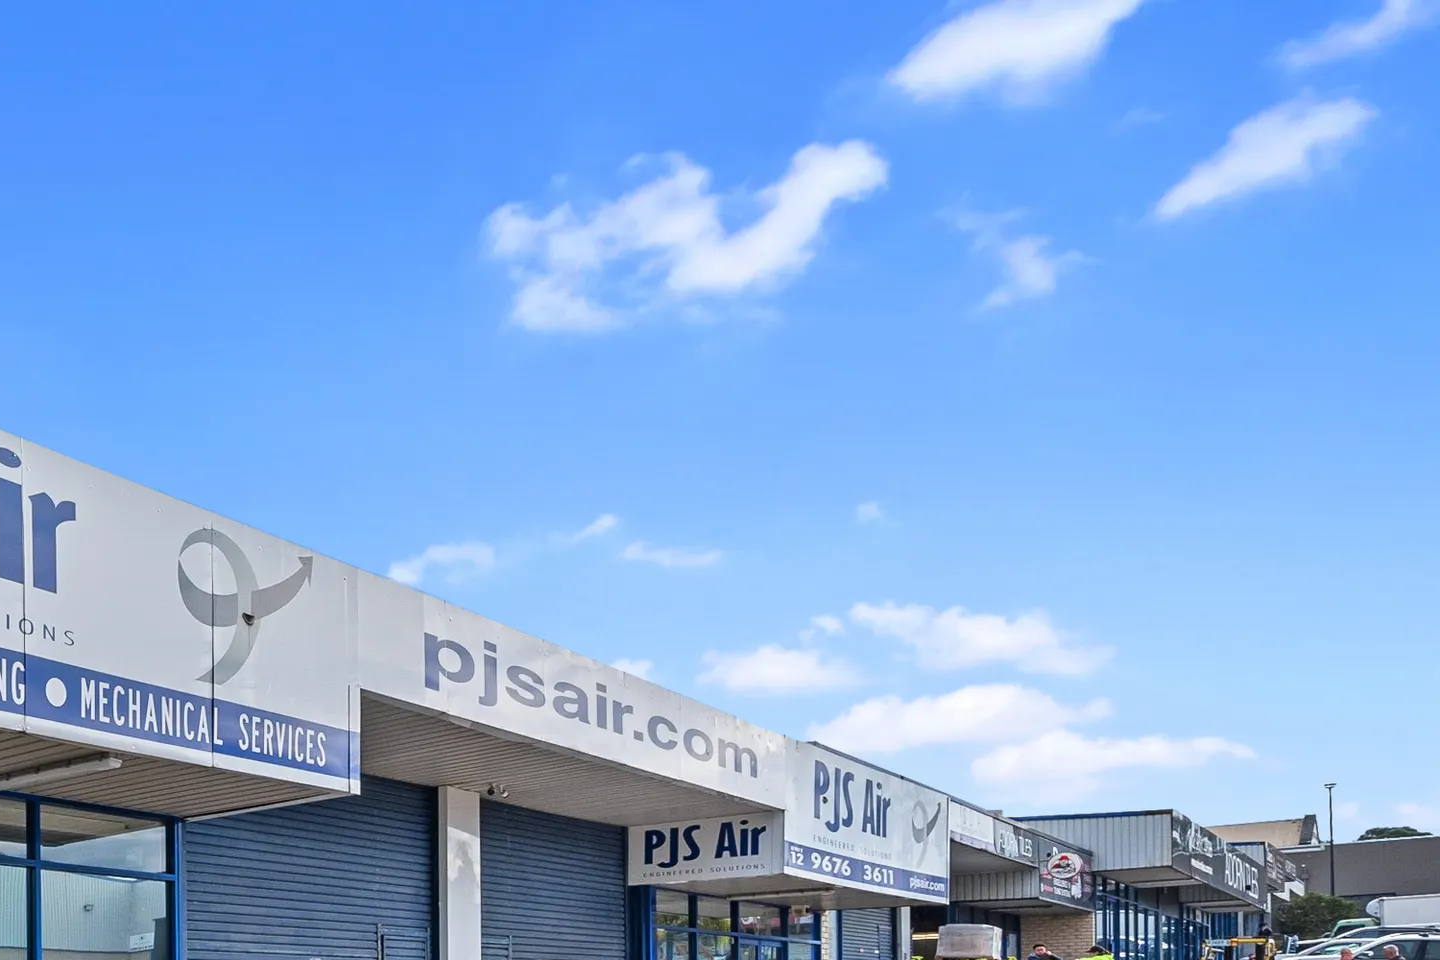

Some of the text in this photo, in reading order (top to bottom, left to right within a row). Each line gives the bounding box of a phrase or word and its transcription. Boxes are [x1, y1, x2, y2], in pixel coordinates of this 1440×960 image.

[424, 631, 758, 779] pjsair.com
[81, 677, 327, 767] MECHANICAL SERVICES
[814, 759, 891, 838] PJS Air
[644, 820, 767, 868] PJS Air
[790, 852, 804, 866] 12
[813, 834, 855, 852] ENGINEERED
[643, 864, 766, 878] ENGINEERED SOLUTIONS
[811, 852, 894, 885] 9676 3611
[909, 875, 945, 892] pjsair.com
